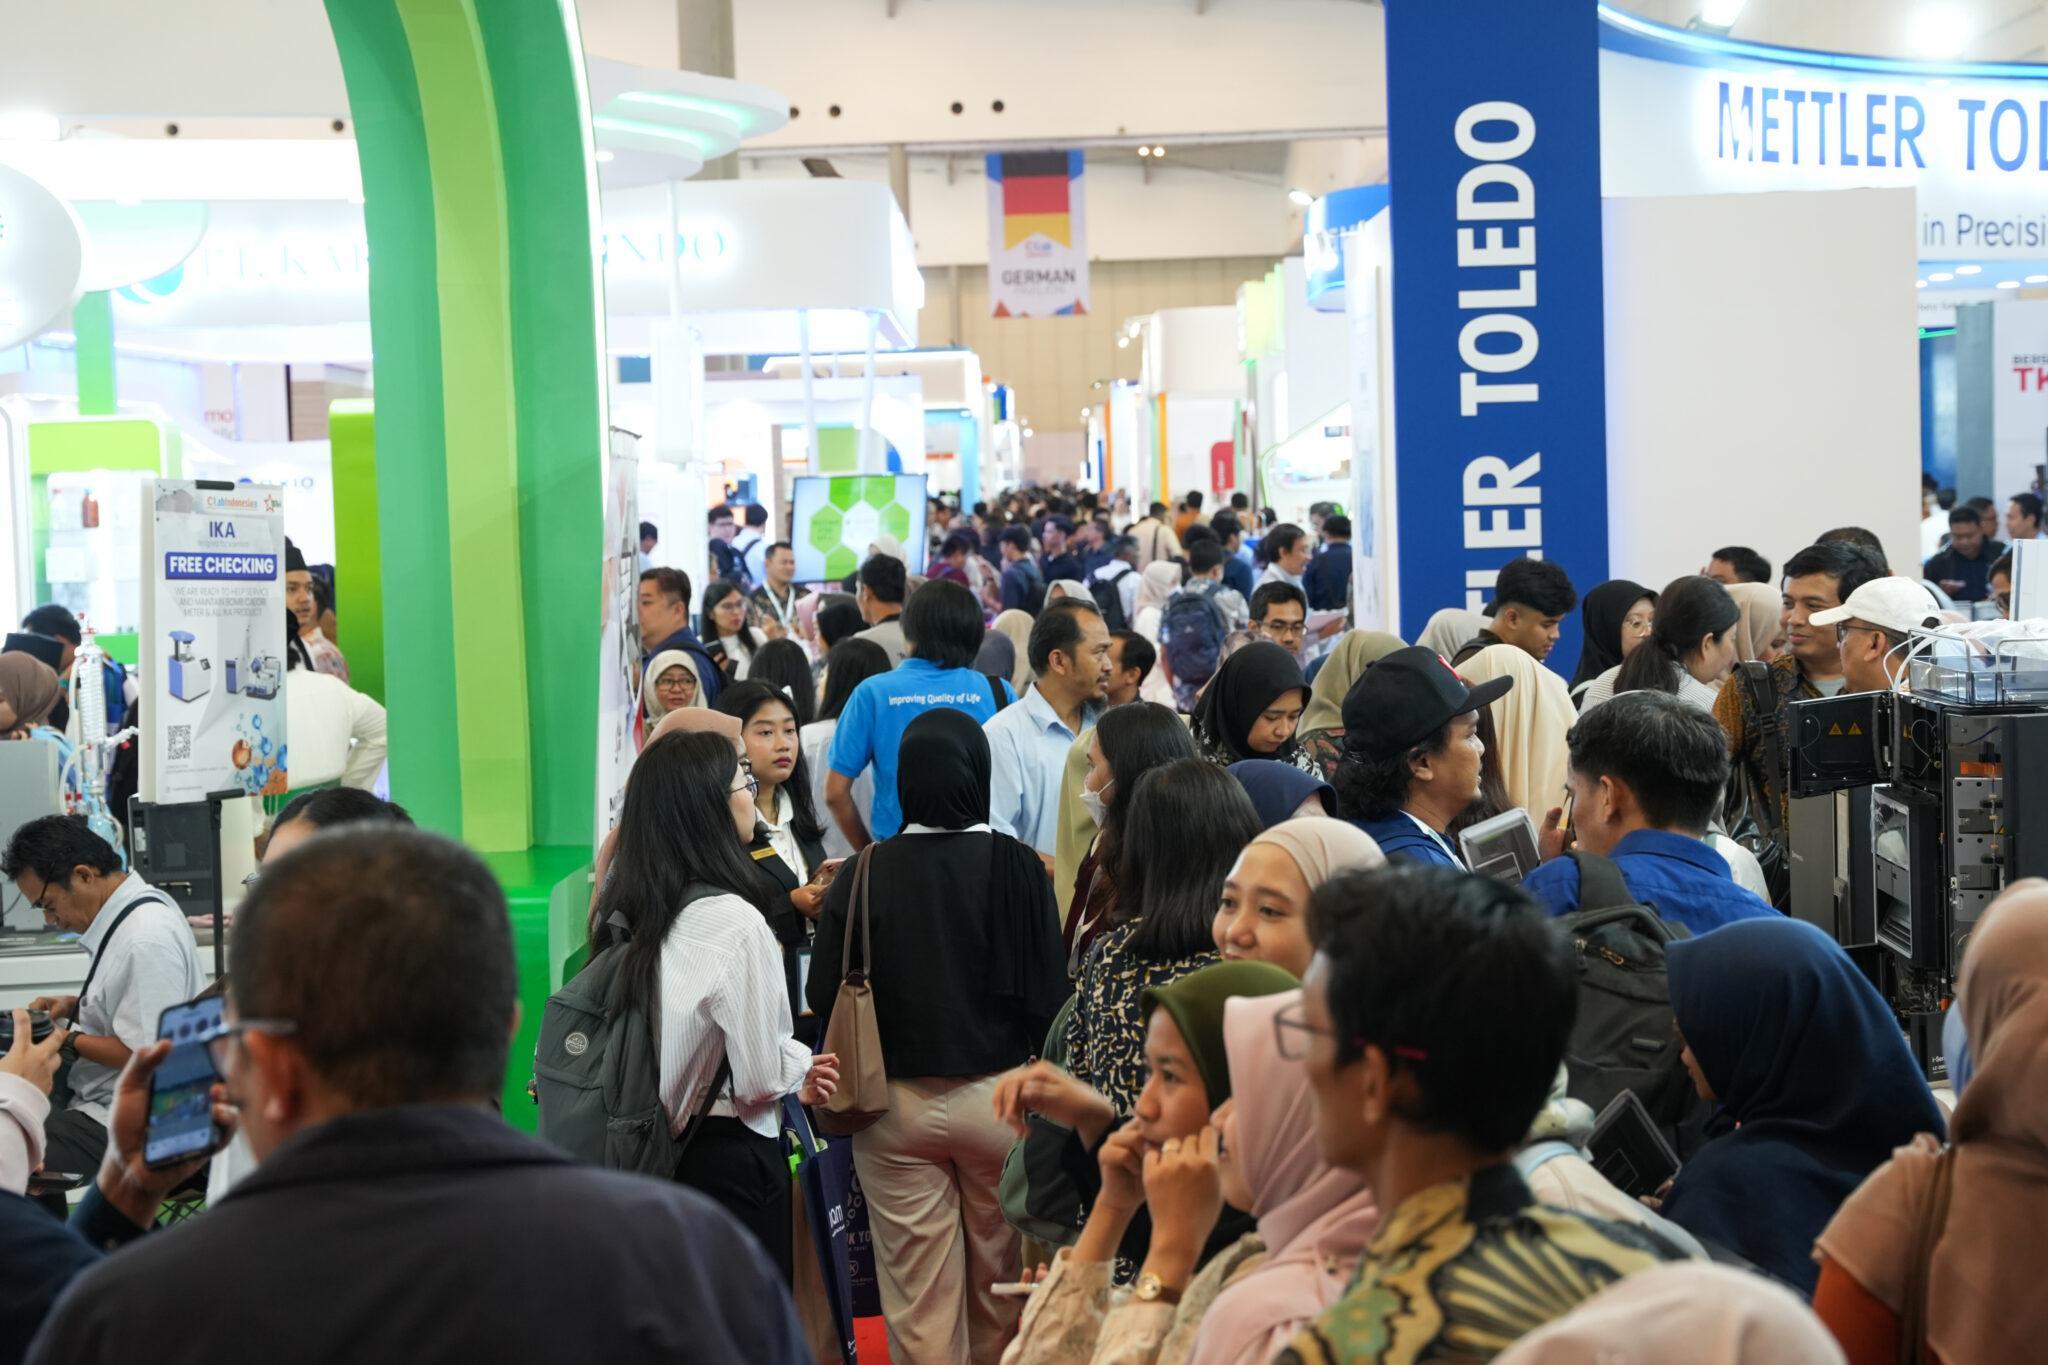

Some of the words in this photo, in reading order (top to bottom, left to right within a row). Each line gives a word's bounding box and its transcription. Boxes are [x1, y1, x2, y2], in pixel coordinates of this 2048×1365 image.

[1718, 81, 1926, 169] METTLER
[1922, 213, 1946, 247] in
[1454, 100, 1540, 417] TOLEDO
[1001, 268, 1076, 286] GERMAN
[208, 521, 236, 539] IKA
[169, 556, 203, 574] FREE
[204, 557, 275, 575] CHECKING
[888, 694, 926, 706] Improving
[927, 693, 955, 704] Quality
[956, 692, 966, 704] of
[966, 692, 981, 703] Life
